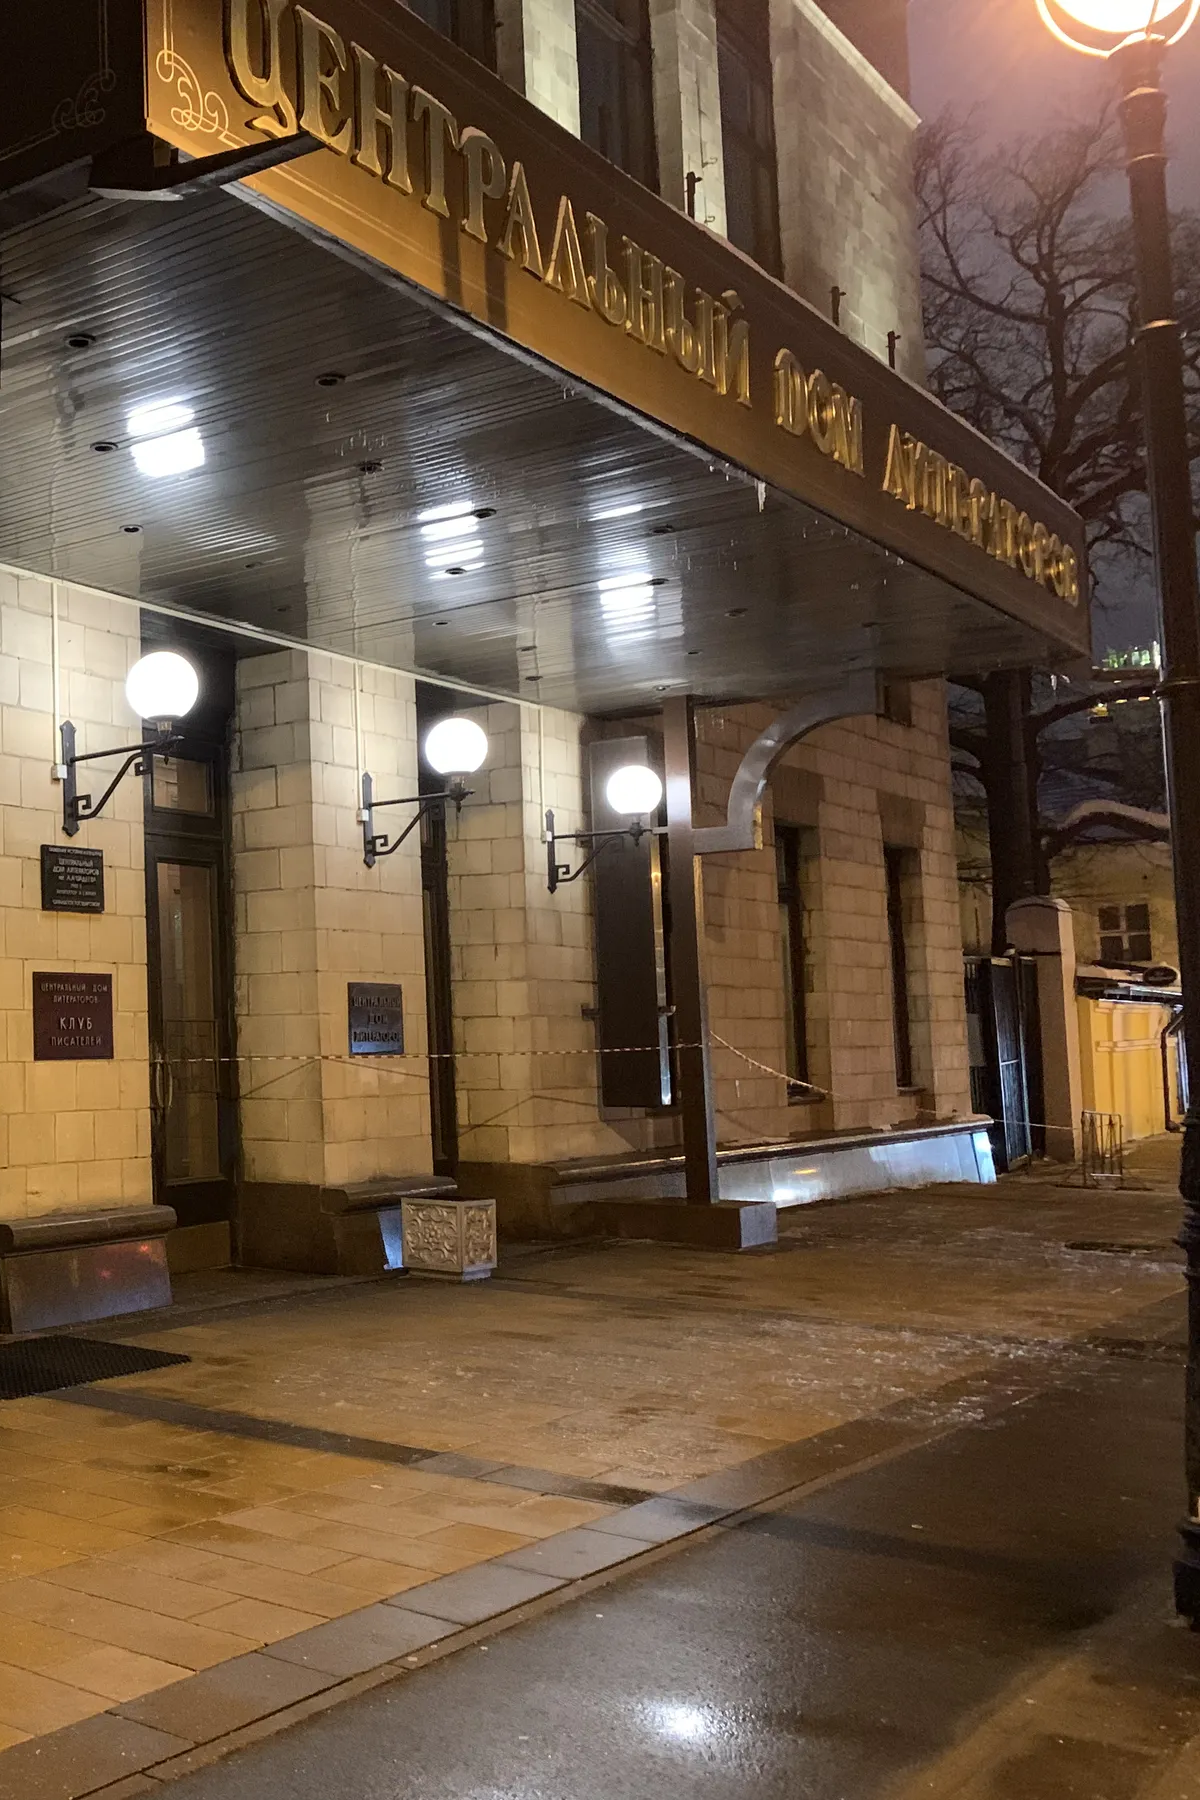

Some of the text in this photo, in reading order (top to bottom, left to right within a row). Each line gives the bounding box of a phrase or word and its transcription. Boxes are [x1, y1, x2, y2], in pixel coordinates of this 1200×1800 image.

[221, 0, 1079, 607] ЦЕНТРАЛЬНЫЙ ДОМ ЛИТЕРАТОРОВ
[41, 983, 108, 993] ЦЕНТРАЛЬНЫЙ ДОМ
[53, 995, 98, 1004] ЛИТЕРАТОРОВ
[60, 1017, 93, 1030] КЛУБ
[51, 1035, 102, 1046] ПИСАТЕЛЕЙ
